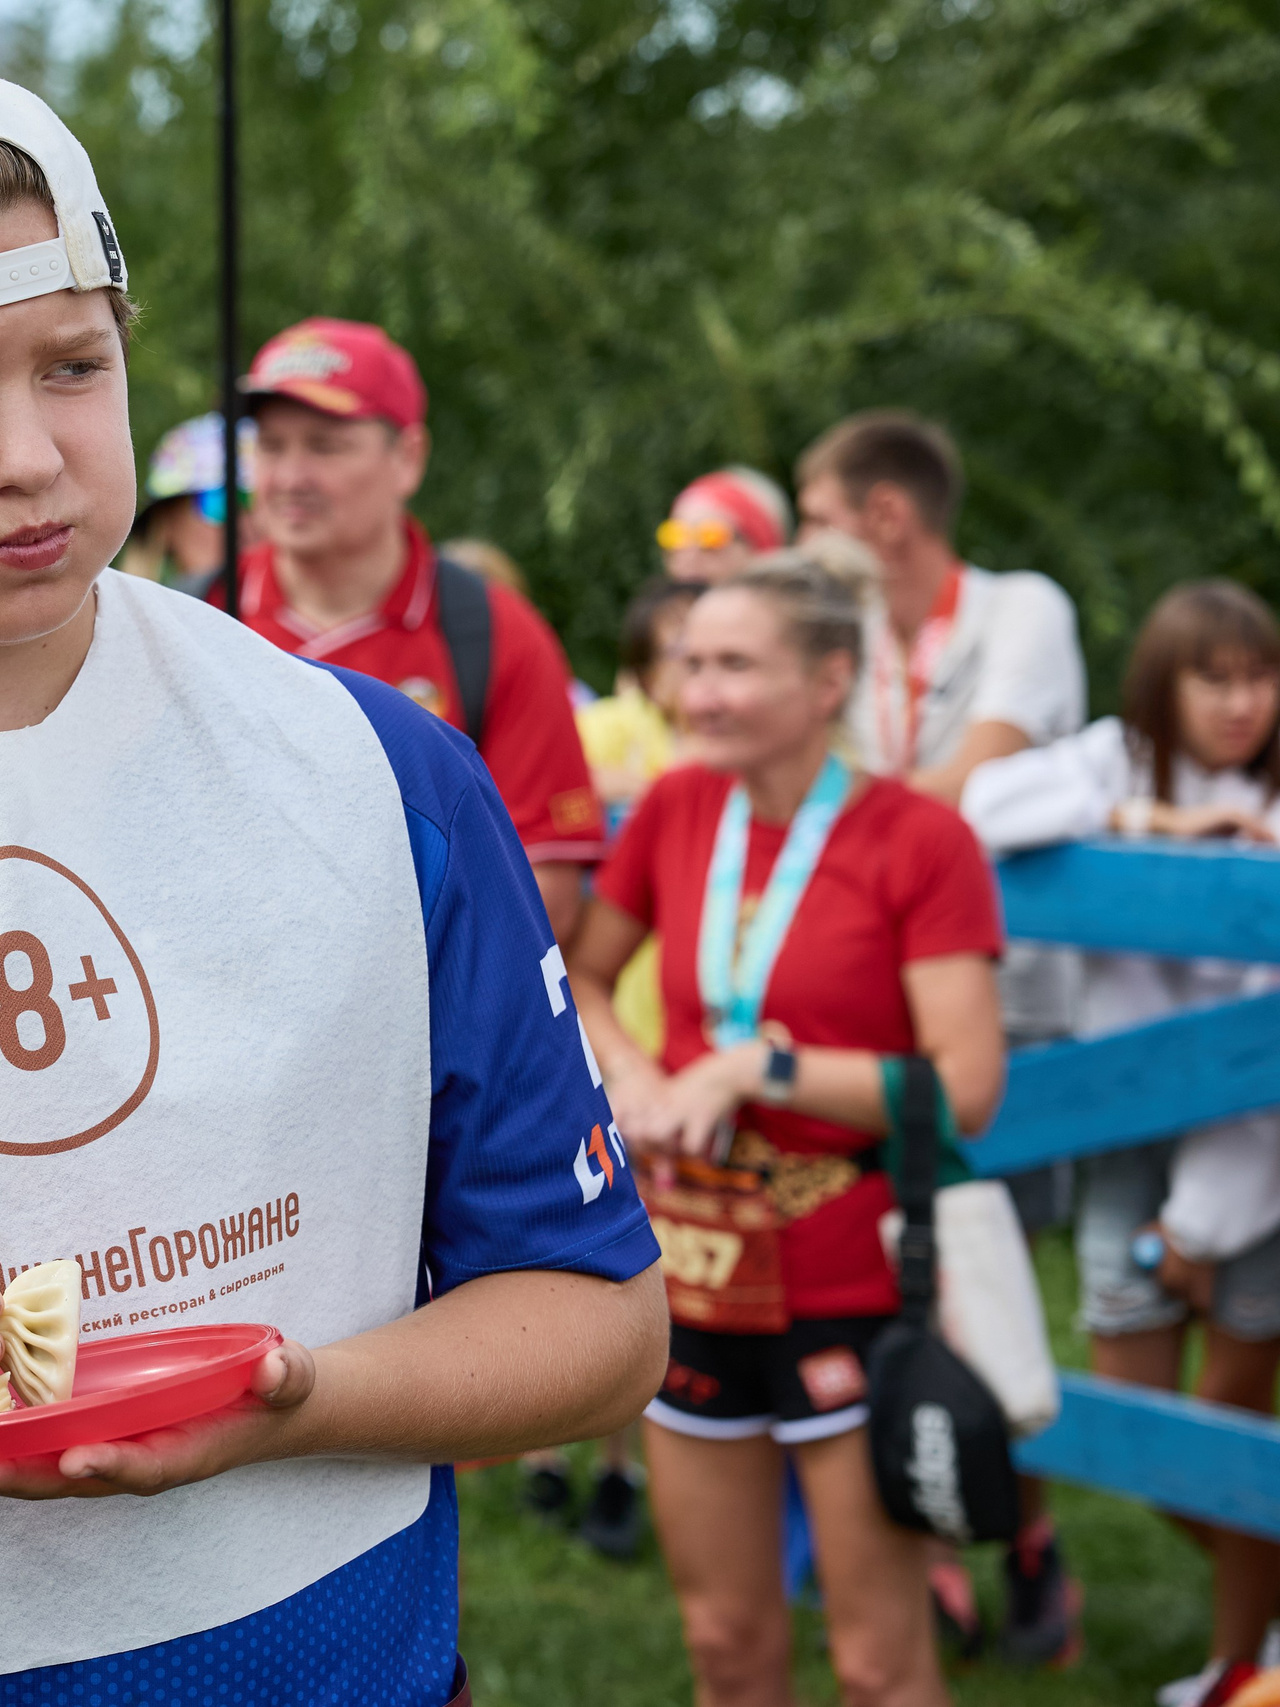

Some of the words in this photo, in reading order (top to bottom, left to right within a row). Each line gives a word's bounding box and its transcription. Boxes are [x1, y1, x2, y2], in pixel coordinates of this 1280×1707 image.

[80, 1312, 124, 1335] ский
[129, 1294, 206, 1326] ресторан
[209, 1287, 217, 1302] &
[220, 1262, 286, 1297] сыроварня
